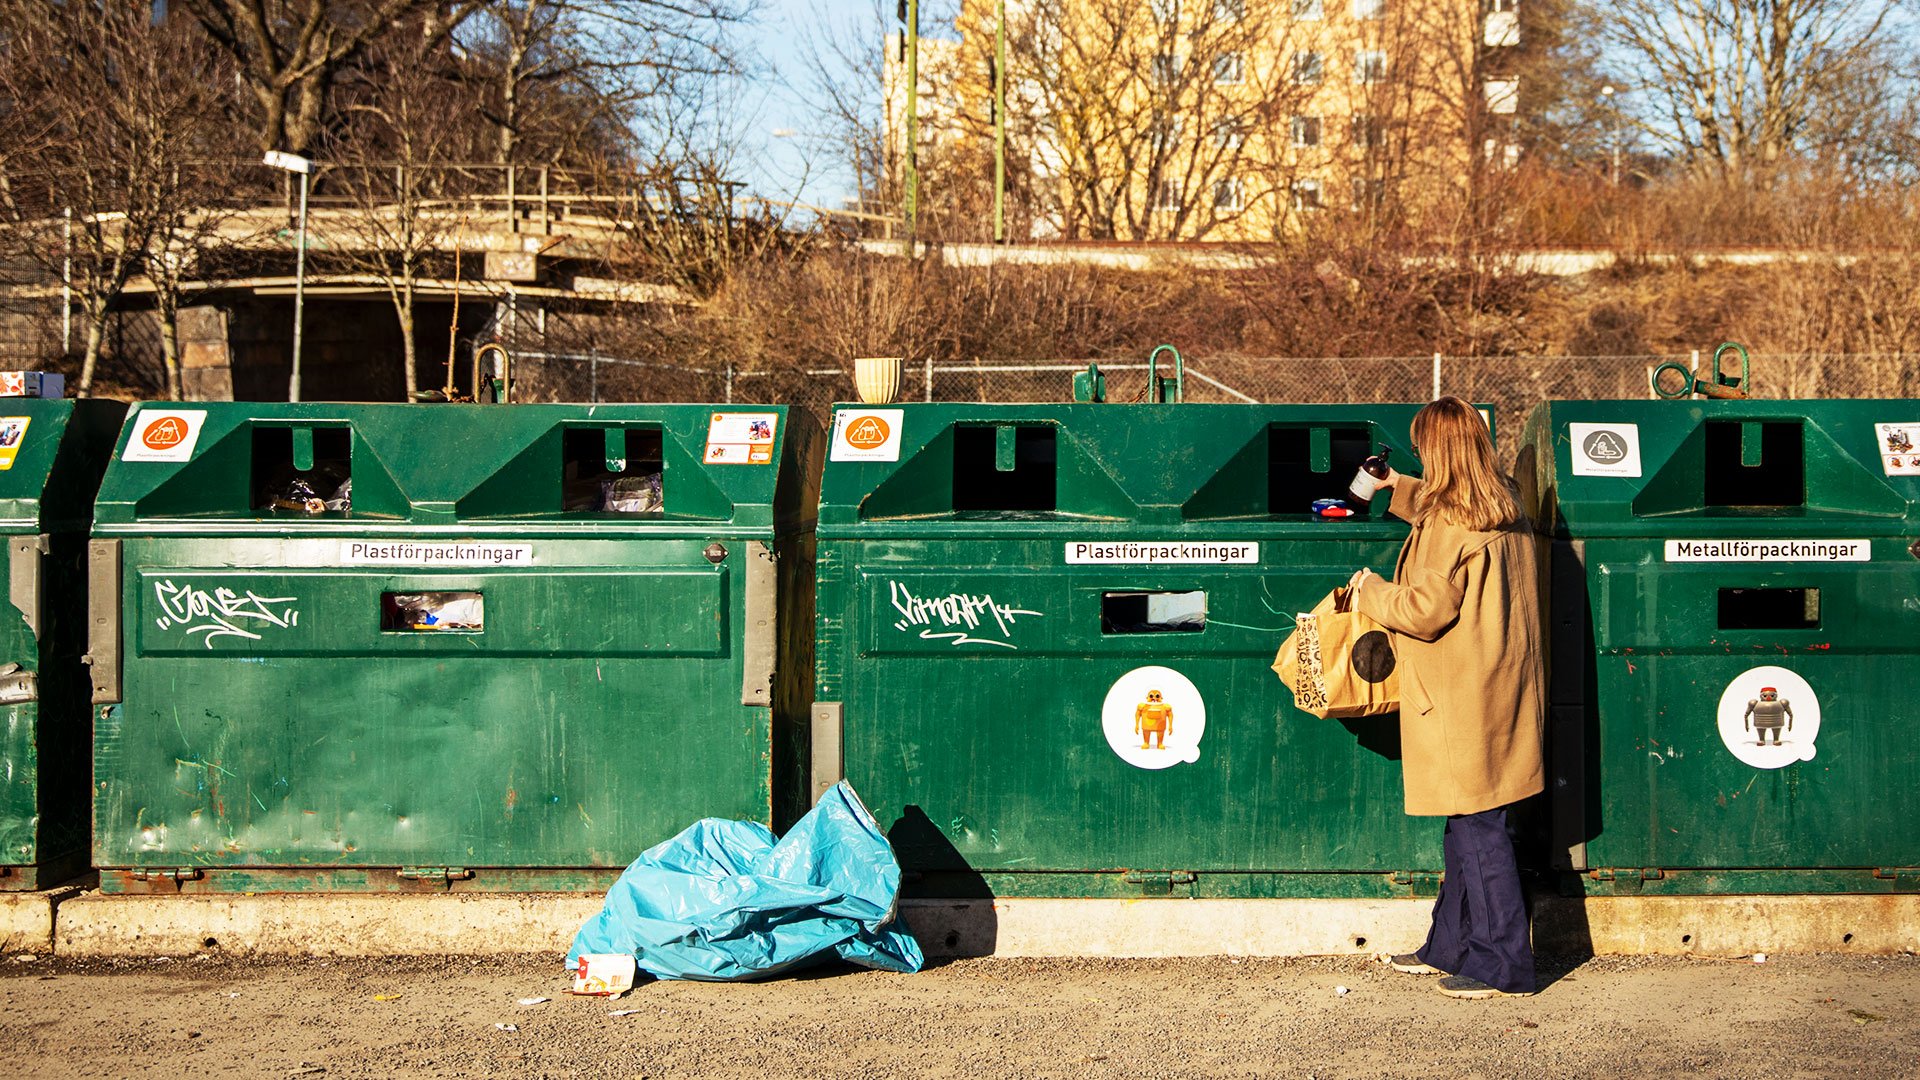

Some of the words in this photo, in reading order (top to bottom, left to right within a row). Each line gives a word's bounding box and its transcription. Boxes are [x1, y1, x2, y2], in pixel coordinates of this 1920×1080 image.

[351, 543, 523, 563] Plastförpackningar
[1076, 543, 1250, 562] Plastförpackningar
[1677, 542, 1858, 560] Metallförpackningar
